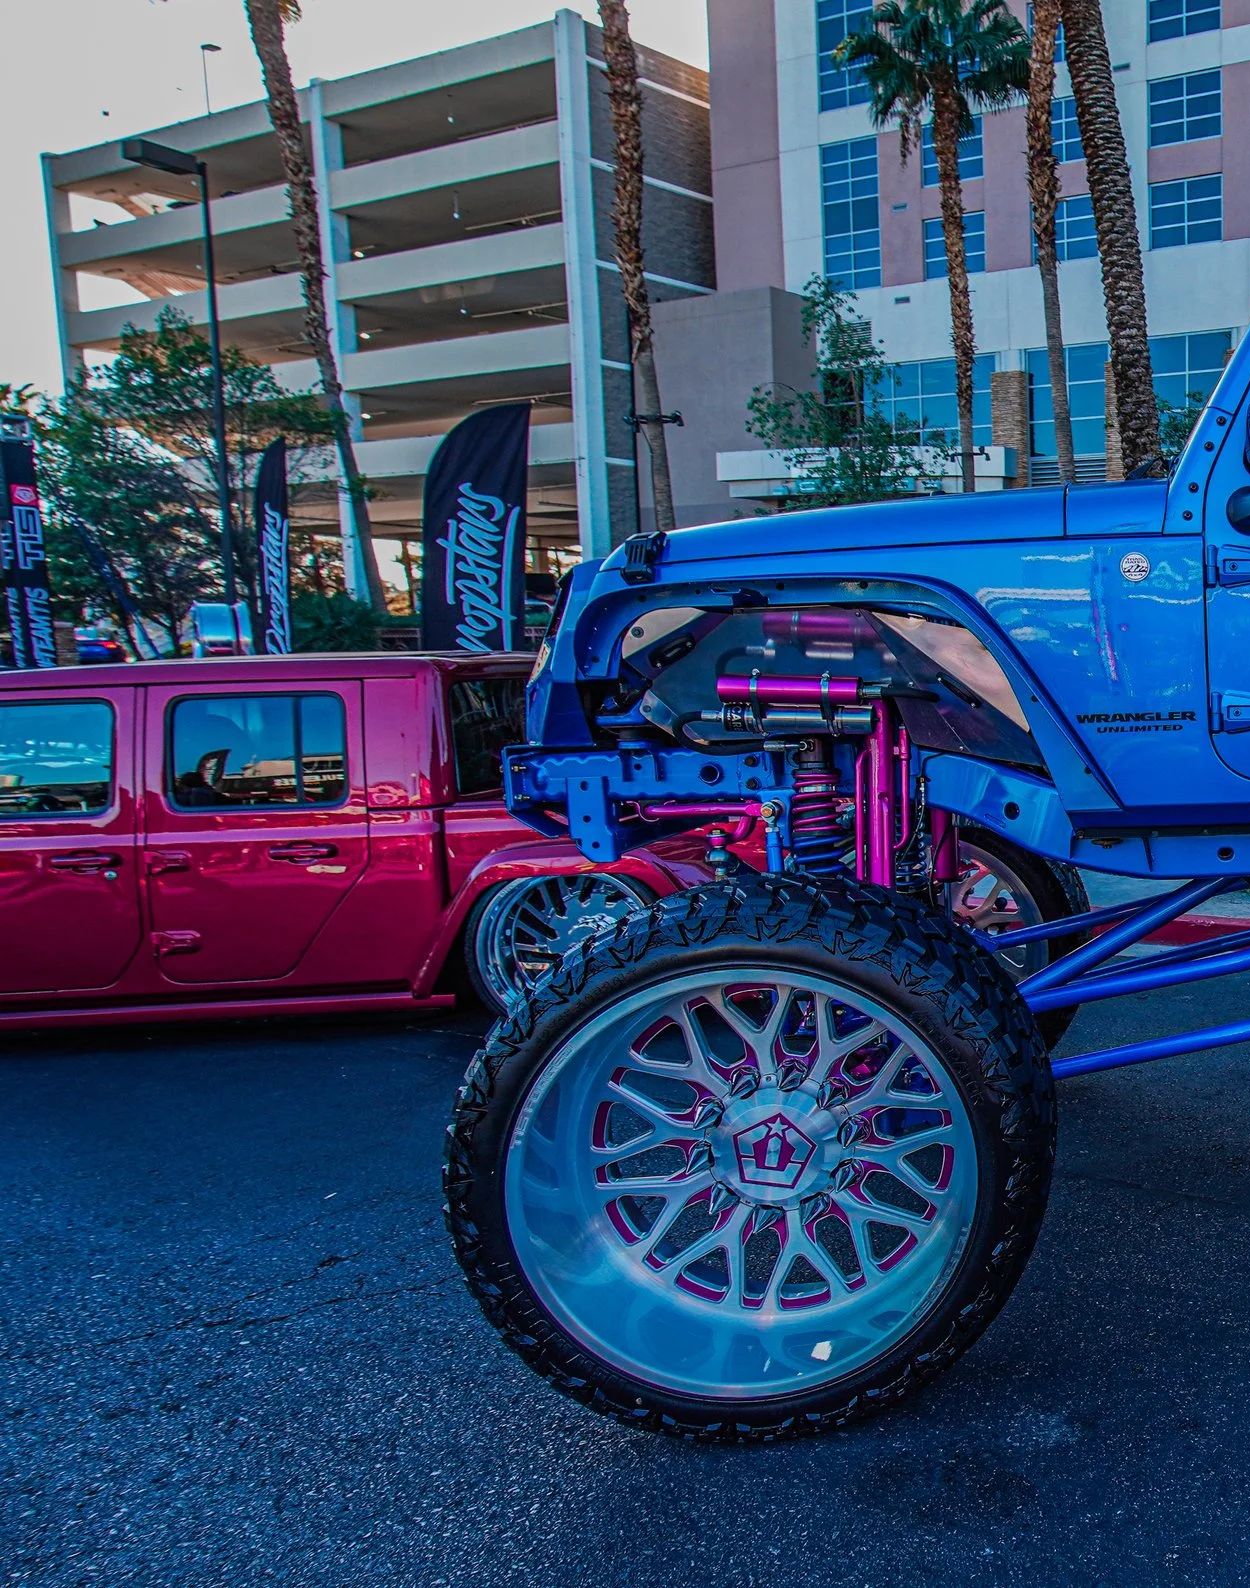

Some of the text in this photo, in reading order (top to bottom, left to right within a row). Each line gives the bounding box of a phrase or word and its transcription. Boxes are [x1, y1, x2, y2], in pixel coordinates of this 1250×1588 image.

[13, 506, 45, 569] TIS
[1076, 711, 1198, 724] WRANGLER
[1096, 724, 1184, 734] UNLIMITED
[510, 1116, 529, 1150] TIS
